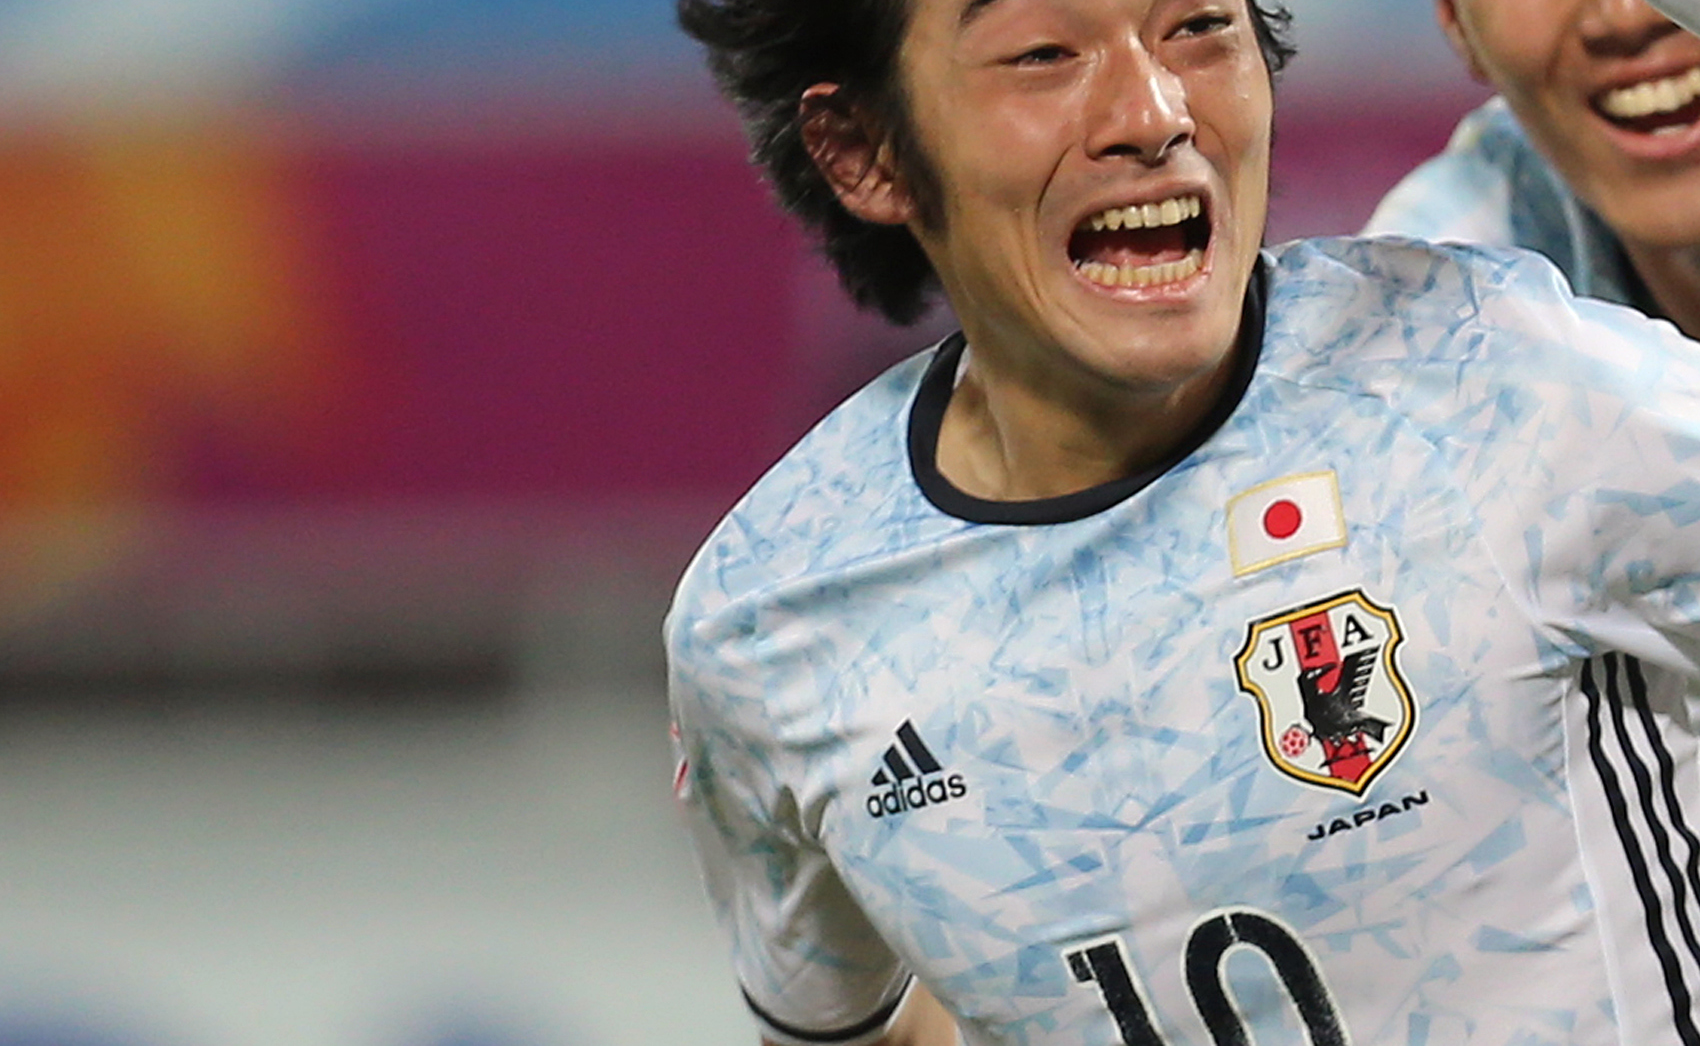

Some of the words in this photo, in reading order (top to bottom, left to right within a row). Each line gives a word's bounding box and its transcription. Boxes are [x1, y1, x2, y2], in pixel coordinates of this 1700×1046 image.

[1263, 614, 1375, 671] JFA
[866, 774, 967, 818] adidas
[1307, 790, 1429, 841] JAPAN
[1062, 907, 1352, 1046] 10
